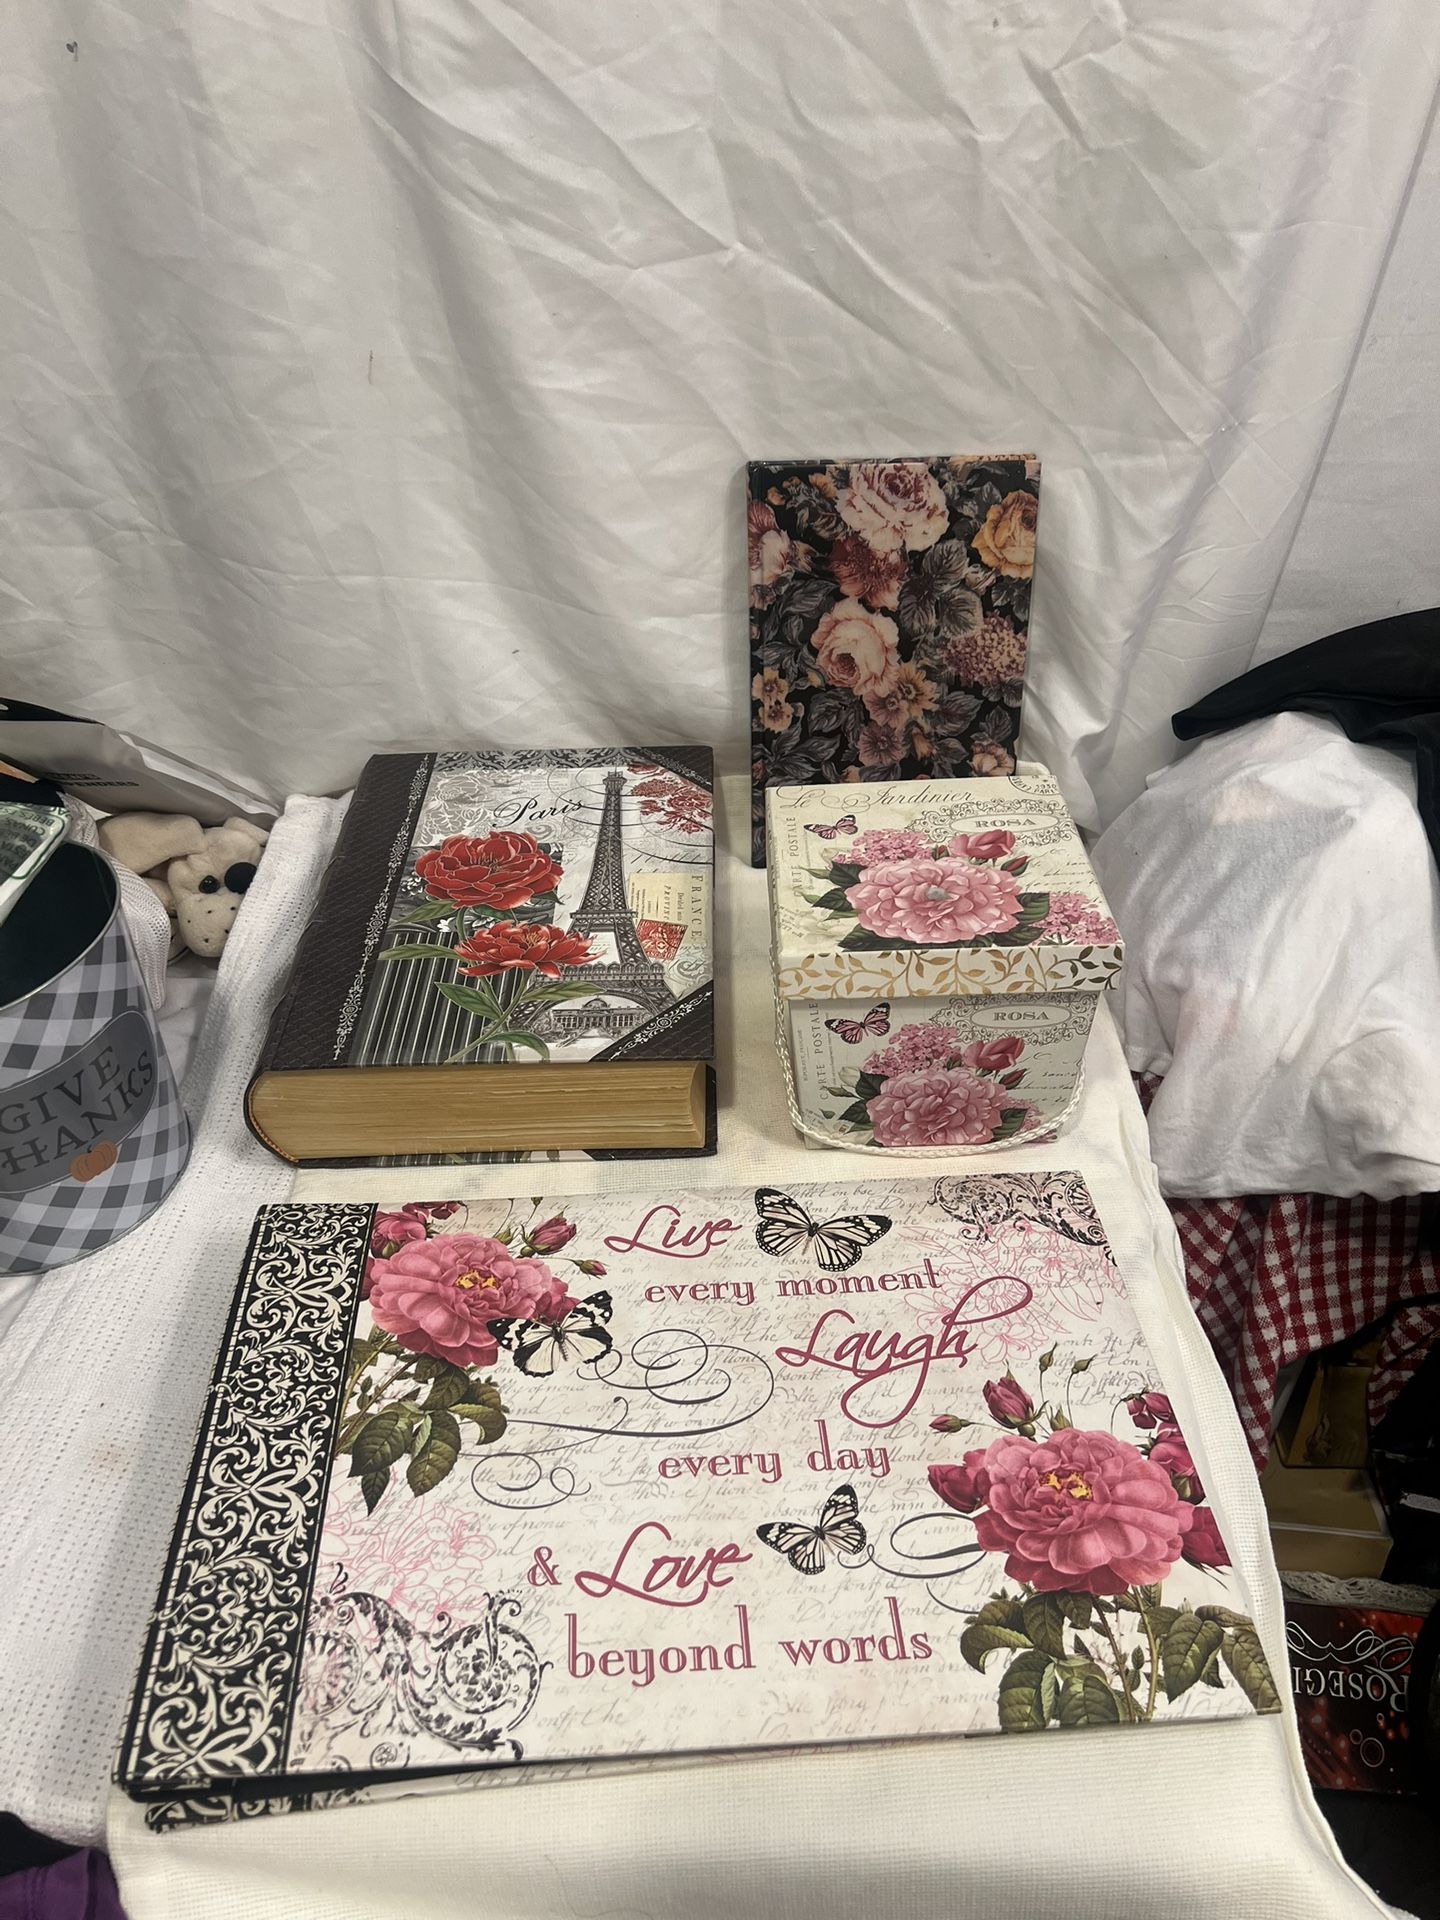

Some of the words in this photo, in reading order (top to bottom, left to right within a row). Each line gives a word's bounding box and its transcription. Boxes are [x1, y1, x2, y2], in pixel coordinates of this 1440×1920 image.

[492, 794, 583, 828] Paris
[786, 817, 800, 857] POSTALE
[974, 818, 1038, 828] ROSA
[809, 1002, 823, 1055] POSTALE
[993, 1011, 1050, 1022] ROSA
[0, 1045, 120, 1135] GIVE
[603, 1204, 742, 1259] Live
[644, 1281, 755, 1307] every
[776, 1258, 943, 1298] moment
[775, 1275, 1034, 1429] Laugh
[657, 1450, 783, 1484] every
[806, 1420, 892, 1478] day
[526, 1545, 563, 1587] &
[574, 1521, 753, 1608] Love
[563, 1604, 757, 1688] beyond
[778, 1596, 933, 1667] words
